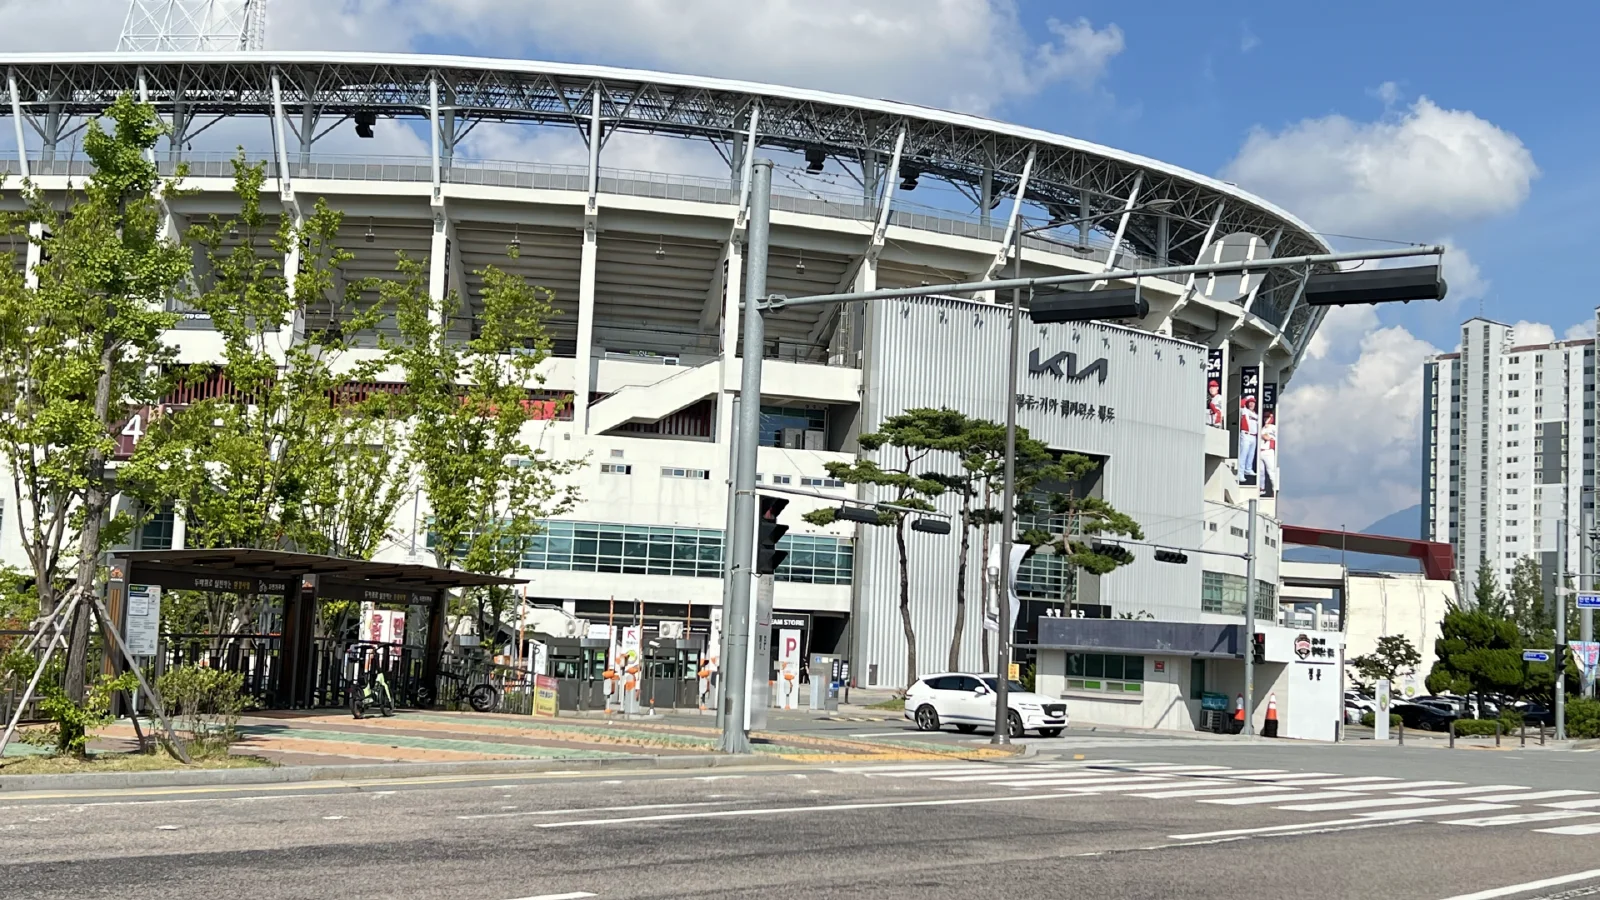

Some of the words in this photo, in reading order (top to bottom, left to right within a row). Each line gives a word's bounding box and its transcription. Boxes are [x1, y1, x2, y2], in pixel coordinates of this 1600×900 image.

[1028, 347, 1108, 381] KIA
[1207, 358, 1221, 370] 54
[1243, 374, 1258, 387] 34
[1264, 391, 1272, 402] 5
[121, 414, 144, 445] 4
[784, 619, 804, 627] STORE
[786, 637, 797, 658] P
